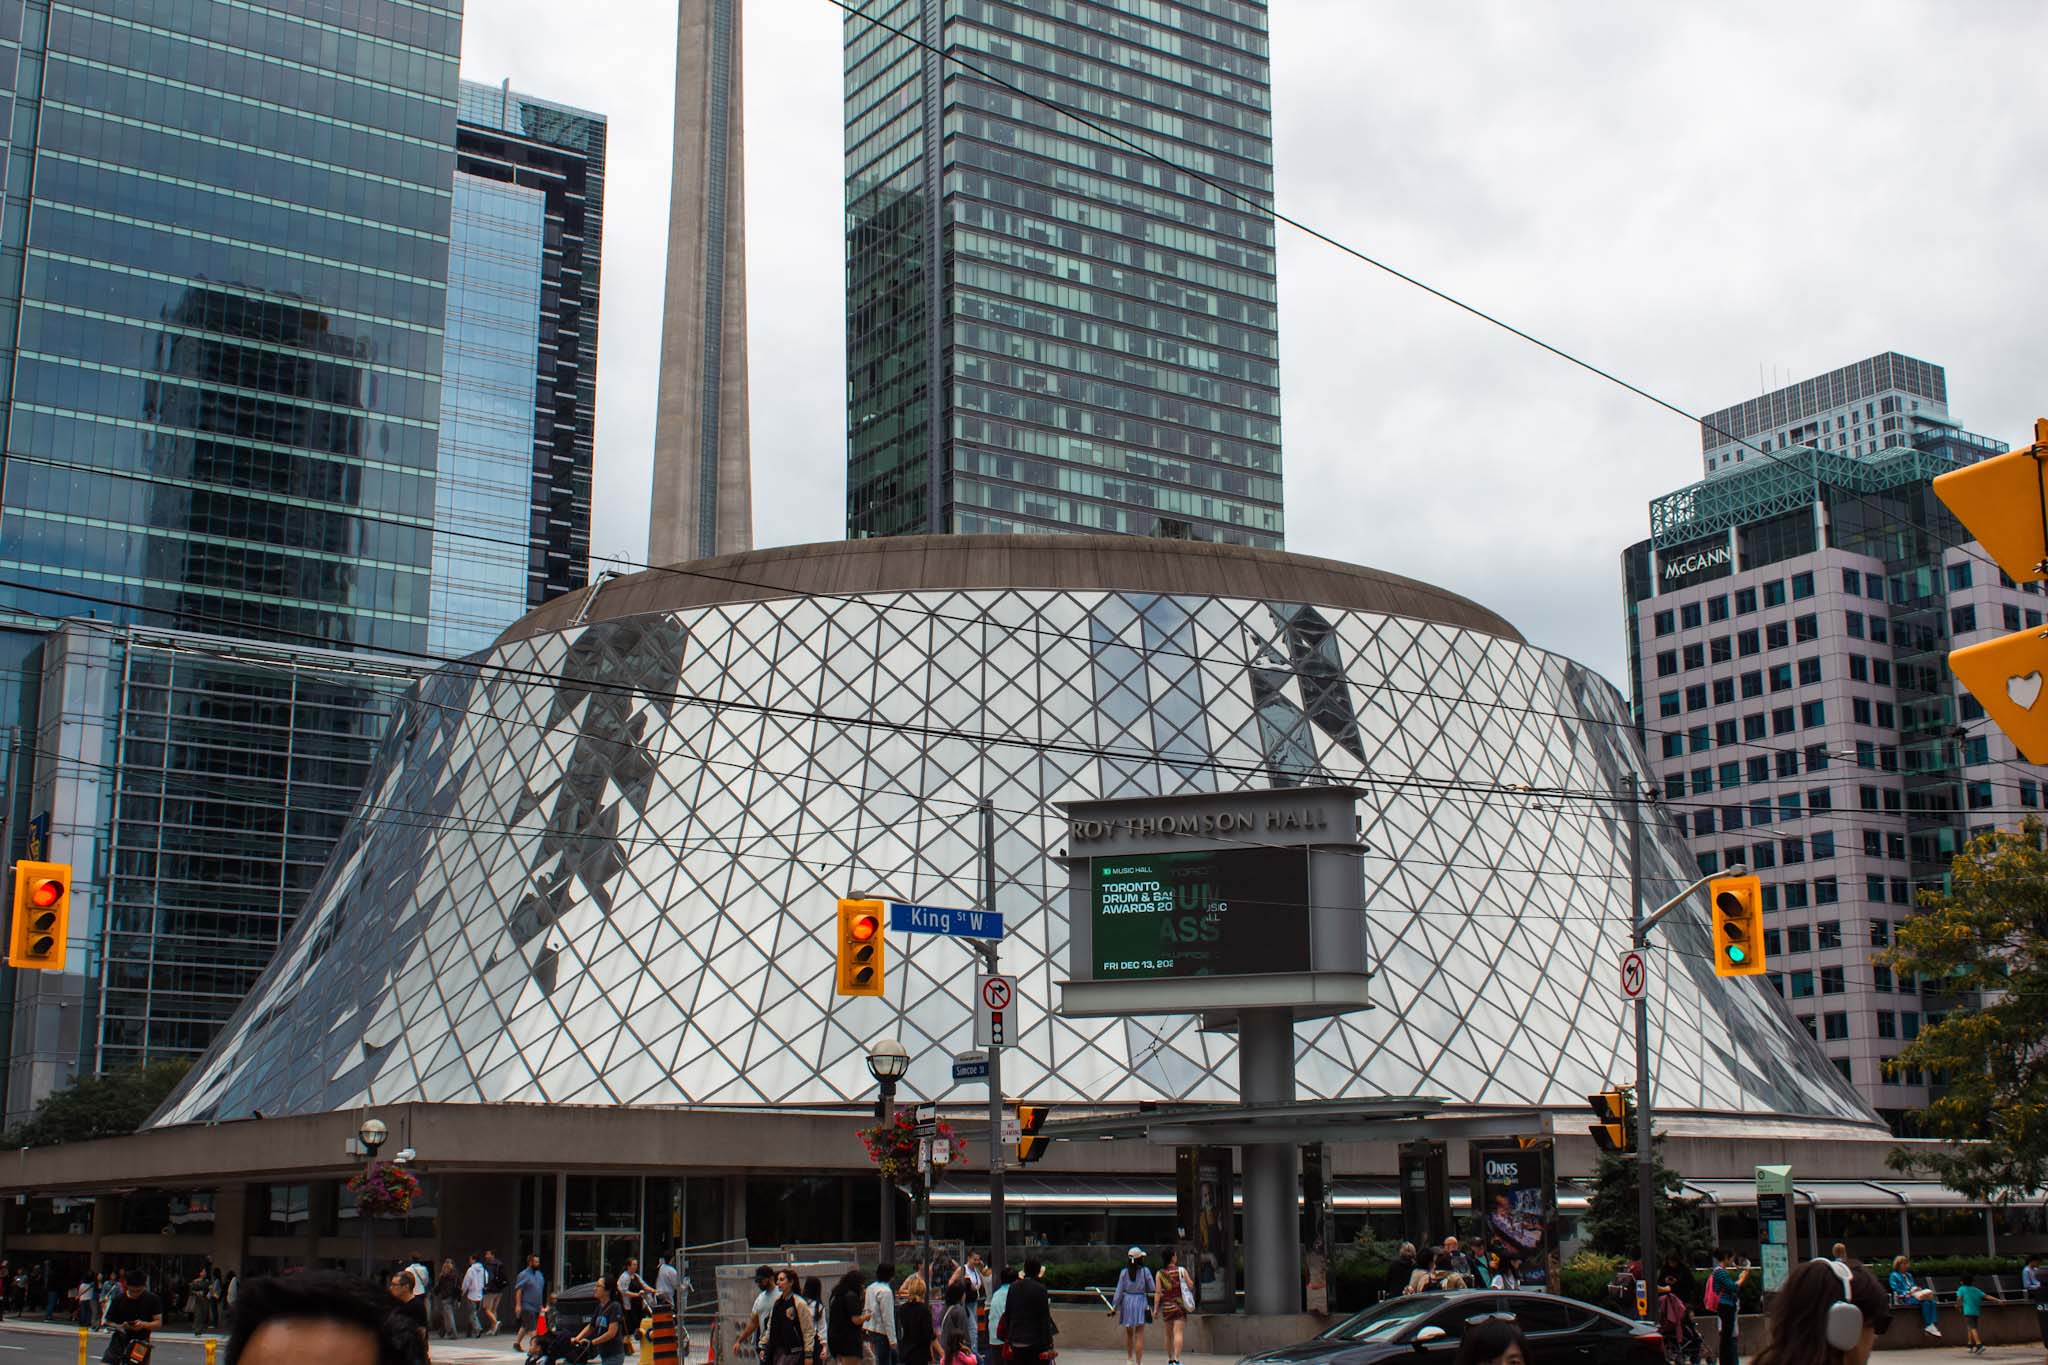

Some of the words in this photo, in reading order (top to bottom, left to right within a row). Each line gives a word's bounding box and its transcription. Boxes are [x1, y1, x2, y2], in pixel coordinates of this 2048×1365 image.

[1665, 545, 1731, 579] McCANN
[1071, 820, 1118, 841] ROY
[1124, 811, 1254, 837] THOMSON
[1265, 808, 1329, 832] HALL
[1112, 867, 1134, 875] MUSIC
[1102, 881, 1160, 893] TORONTO
[1102, 893, 1138, 904] DRUM
[1141, 892, 1150, 902] &
[1102, 902, 1155, 914] AWARDS
[911, 907, 950, 933] King
[957, 911, 967, 921] St
[970, 912, 983, 931] W
[1103, 962, 1118, 970] FRI
[1120, 961, 1140, 969] DEC
[1141, 961, 1155, 969] 13,
[956, 1065, 977, 1077] Simcoe
[1486, 1160, 1518, 1176] ONES
